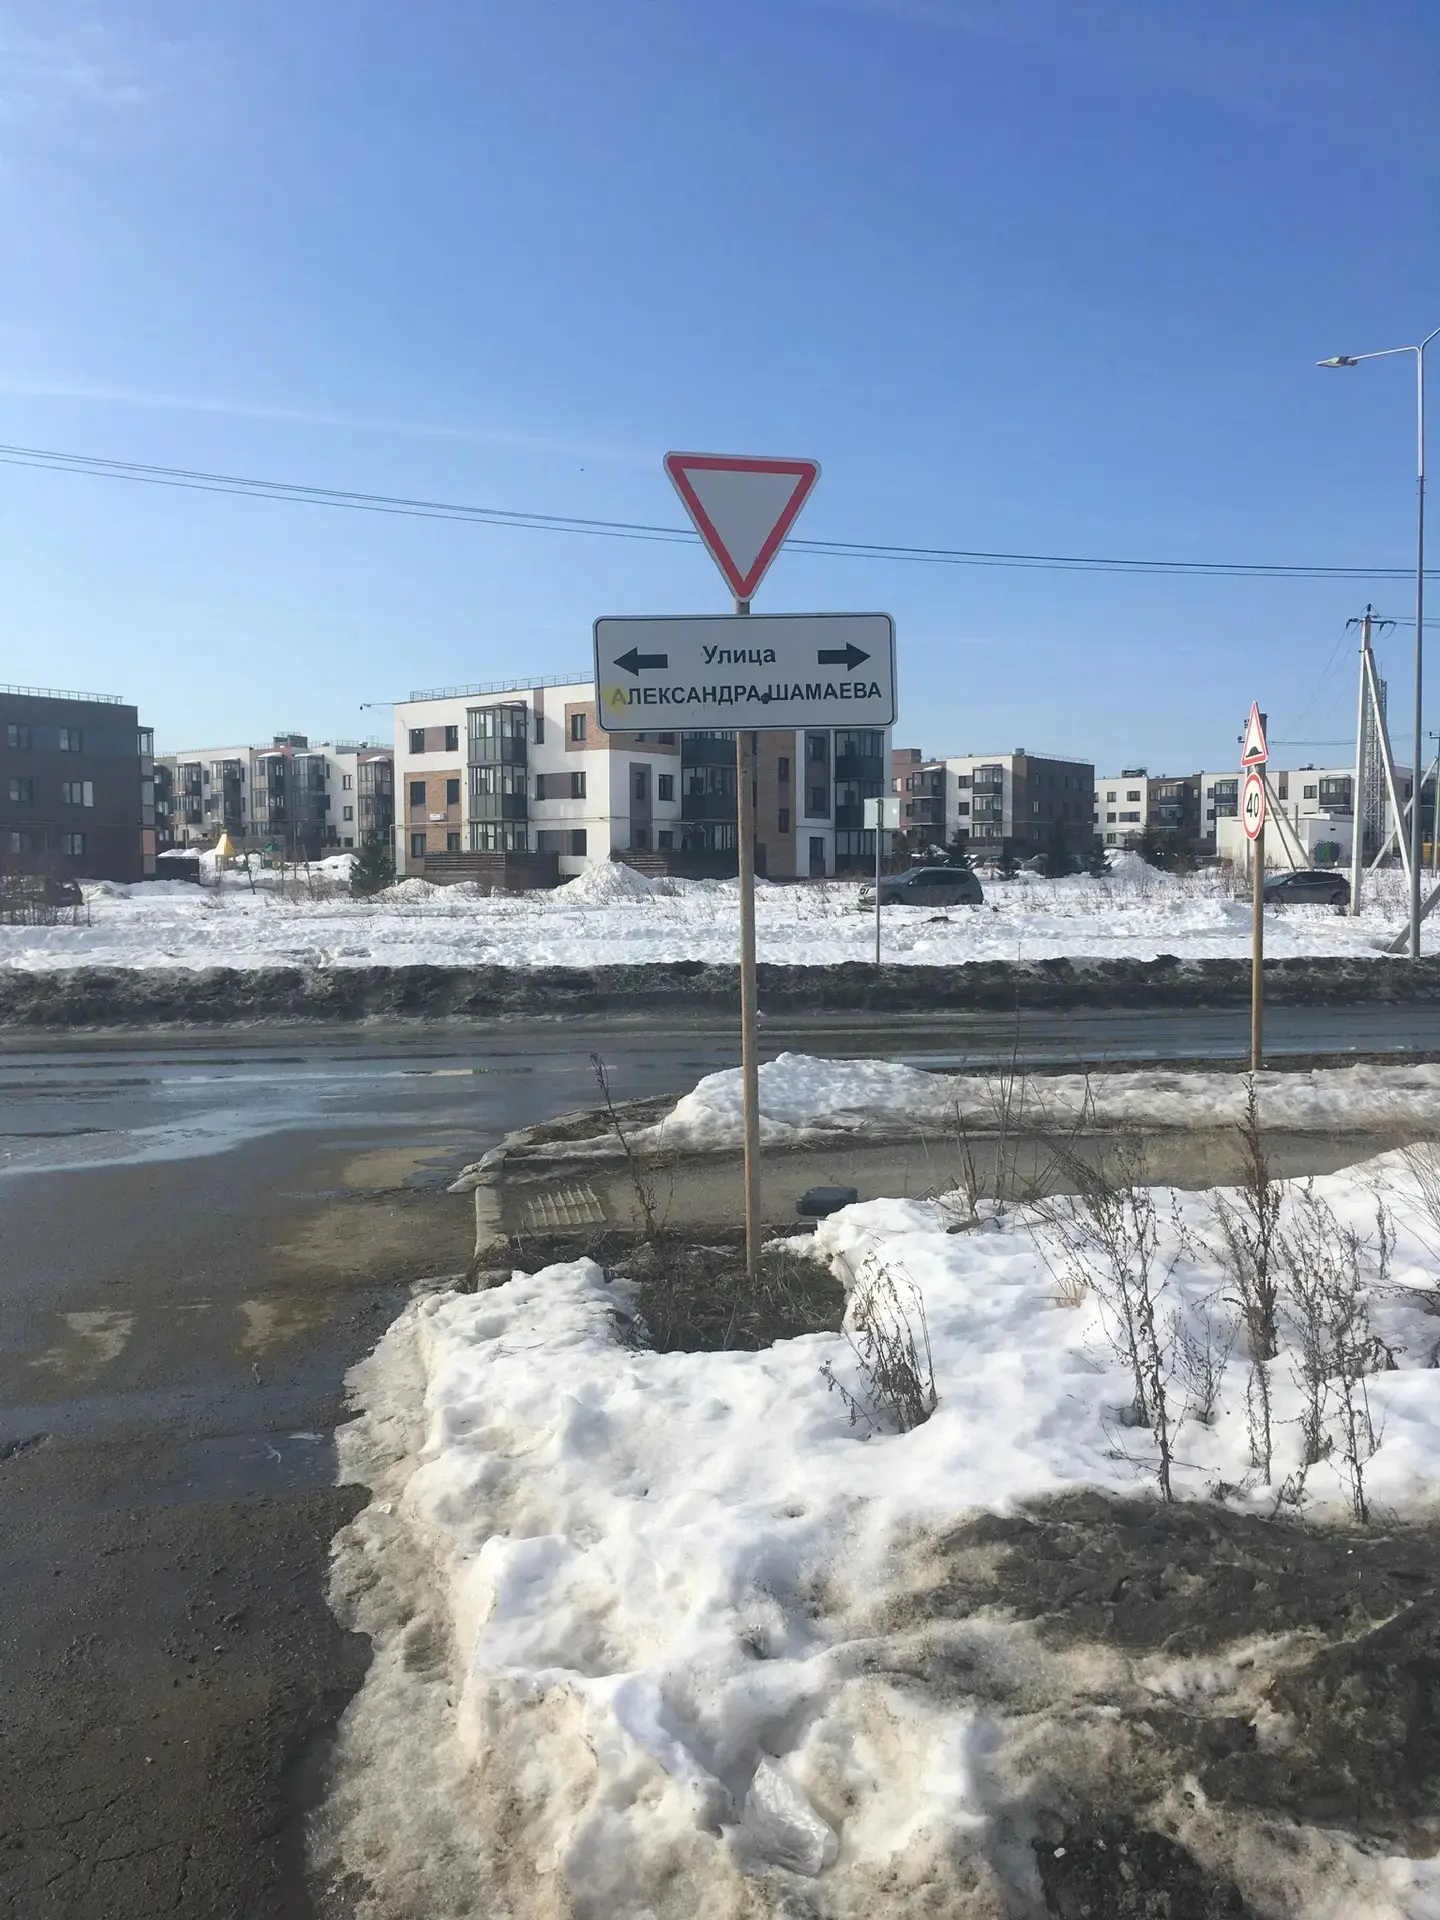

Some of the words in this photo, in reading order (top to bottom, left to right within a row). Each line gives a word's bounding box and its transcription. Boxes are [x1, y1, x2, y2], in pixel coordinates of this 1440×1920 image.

[702, 645, 776, 666] Улица
[611, 685, 761, 706] АЛЕКСАНДРА
[768, 682, 882, 701] ШАМАЕВА
[1246, 793, 1259, 817] 40
